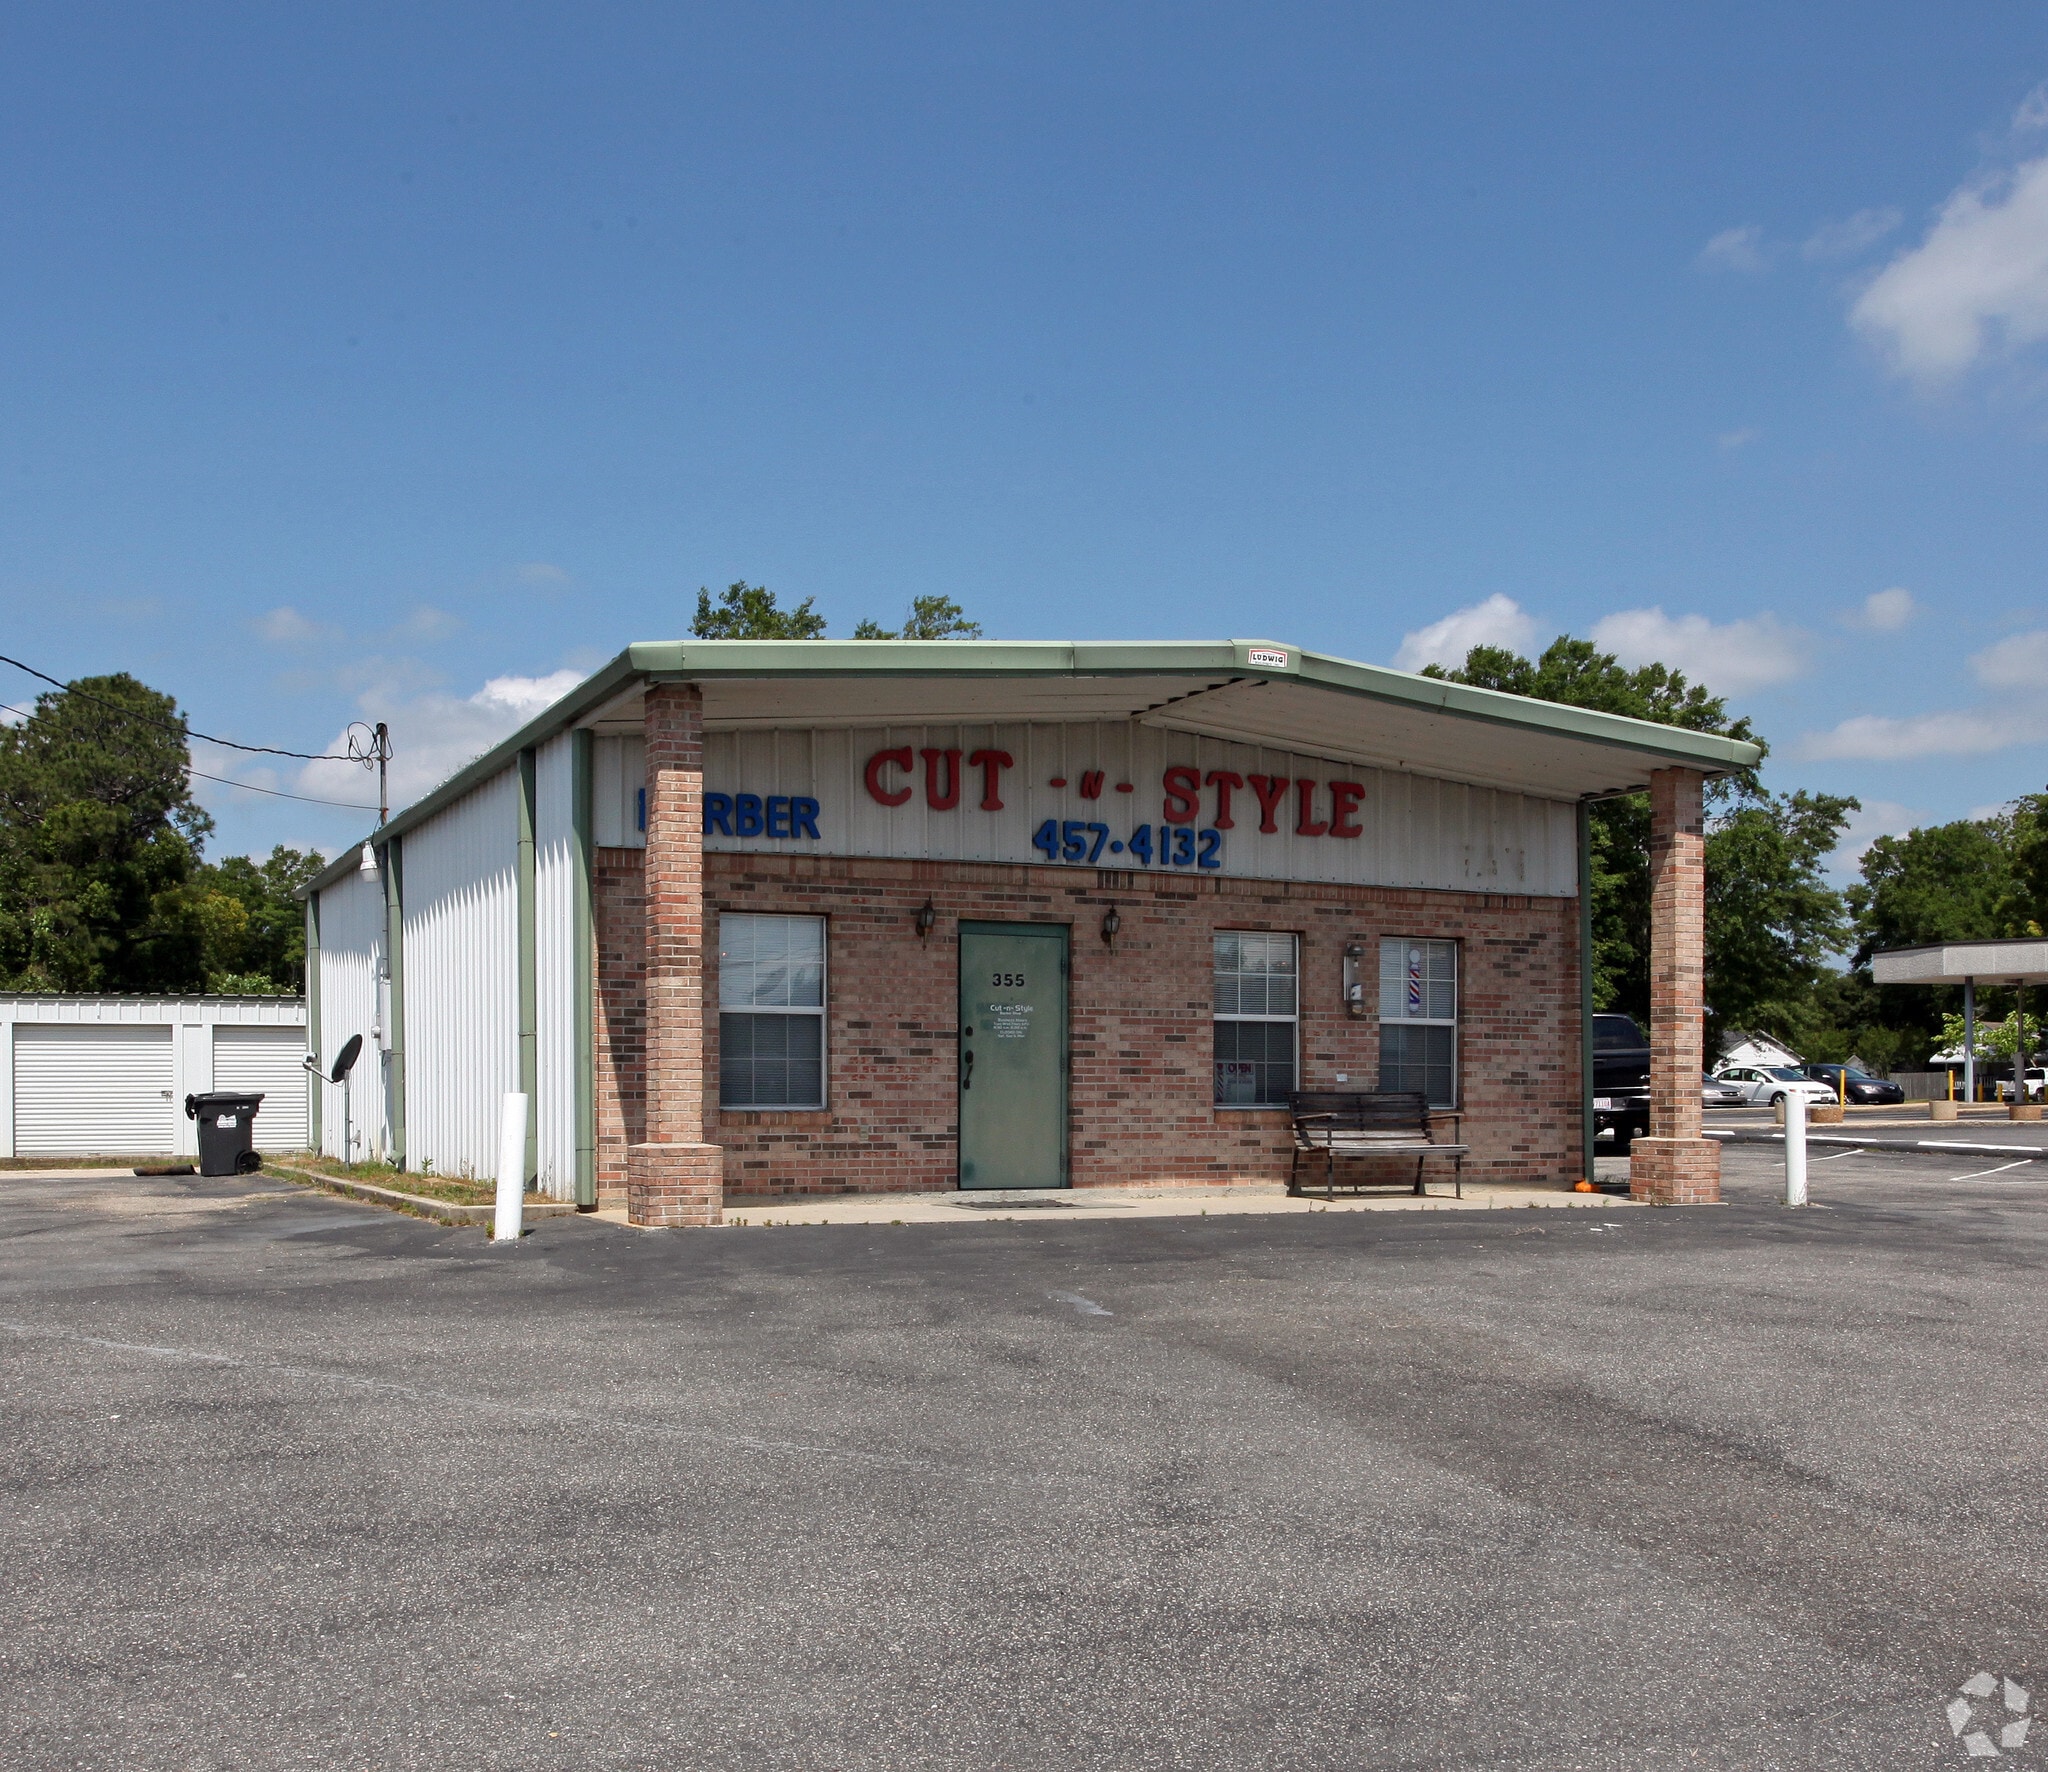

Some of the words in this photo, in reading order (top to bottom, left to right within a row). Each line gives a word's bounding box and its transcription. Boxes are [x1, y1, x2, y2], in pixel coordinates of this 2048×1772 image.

[1252, 654, 1283, 663] LUDWIG
[865, 746, 1014, 811] CUT
[1163, 766, 1366, 838] STYLE
[638, 787, 821, 840] RBER
[992, 973, 1025, 987] 355
